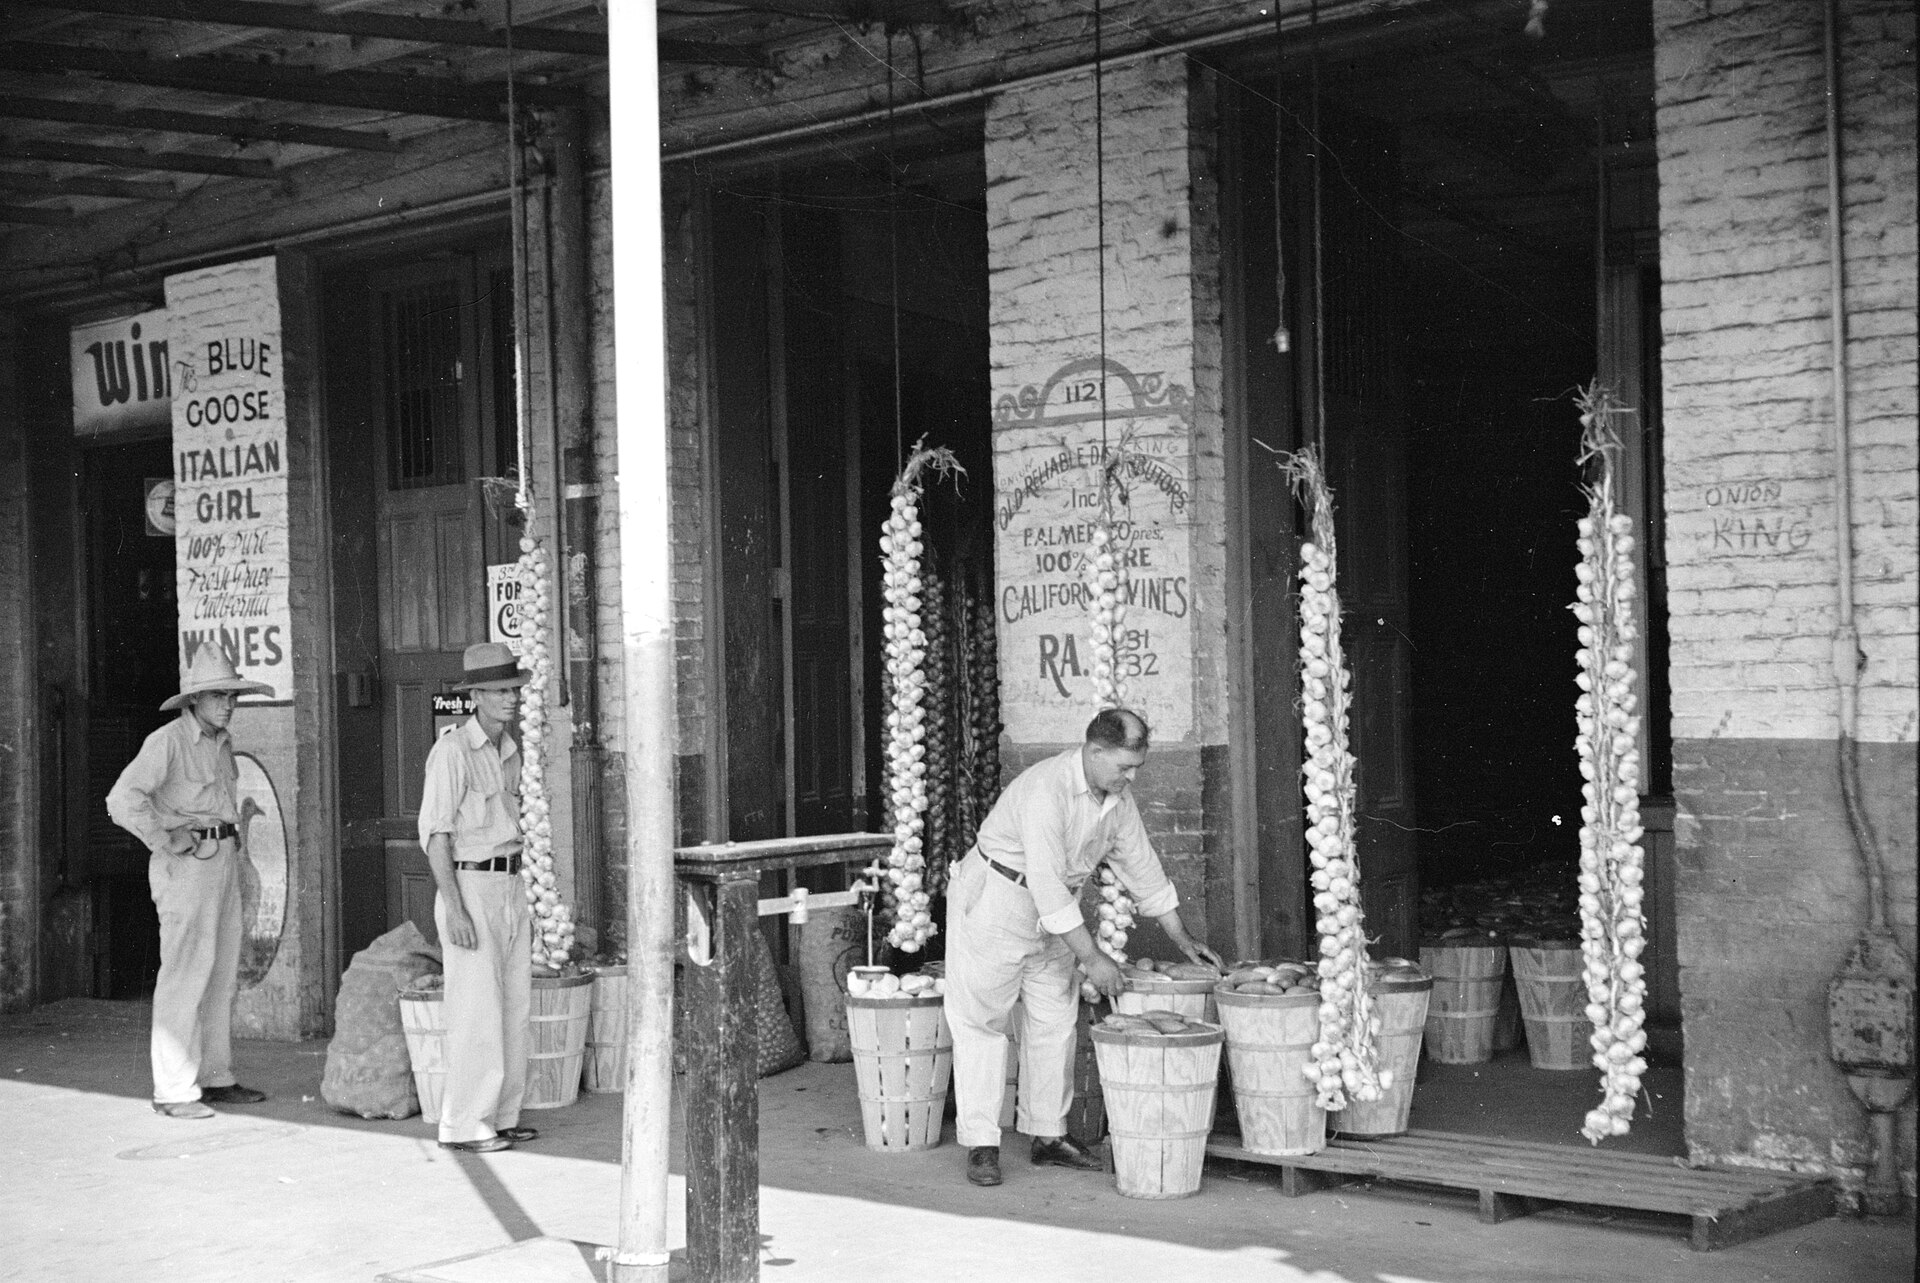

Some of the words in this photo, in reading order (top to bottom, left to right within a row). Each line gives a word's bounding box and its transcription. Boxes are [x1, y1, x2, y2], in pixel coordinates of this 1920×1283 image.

[208, 337, 272, 378] BLUE
[187, 390, 270, 428] GOOSE
[180, 440, 280, 482] ITALIAN
[197, 487, 261, 524] GIRL
[1705, 484, 1782, 507] ONION
[187, 533, 226, 564] 100%
[1713, 516, 1813, 549] KING
[1035, 550, 1088, 573] 100%
[1003, 581, 1096, 624] CALIFORN
[1039, 634, 1090, 699] RA.
